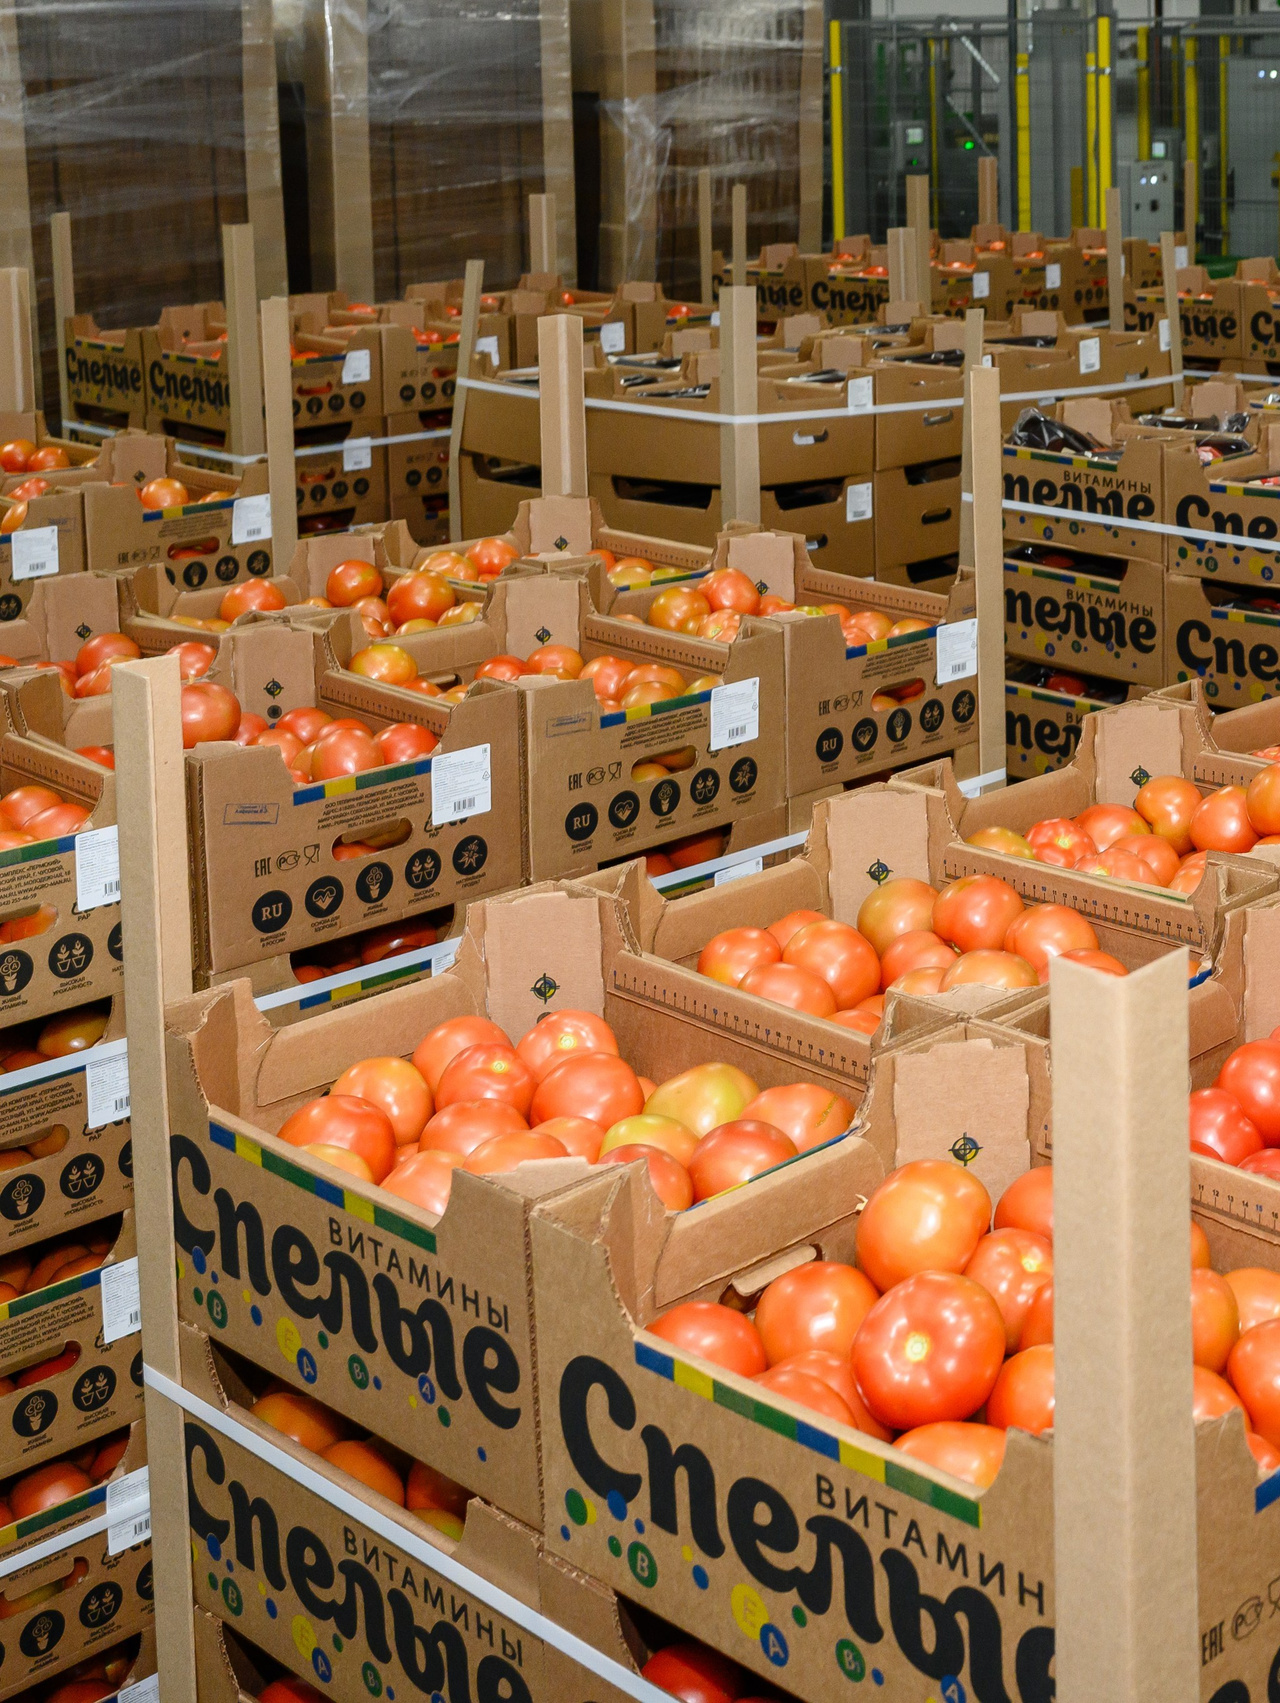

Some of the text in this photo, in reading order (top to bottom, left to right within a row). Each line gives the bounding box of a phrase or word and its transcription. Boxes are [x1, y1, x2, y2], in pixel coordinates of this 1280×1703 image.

[1063, 470, 1152, 494] ВИТАМИНЫ
[1004, 588, 1157, 653] пелые
[1066, 589, 1153, 618] ВИТАМИНЫ
[822, 737, 838, 753] RU
[573, 813, 592, 830] RU
[254, 857, 272, 878] EAC
[262, 902, 284, 921] RU
[171, 1134, 521, 1430] Спелые
[329, 1217, 509, 1333] ВИТАМИНЫ
[817, 1473, 1045, 1616] ВИТАМИН
[343, 1525, 523, 1667] ВИТАМИНЫ
[1201, 1618, 1226, 1666] EAC
